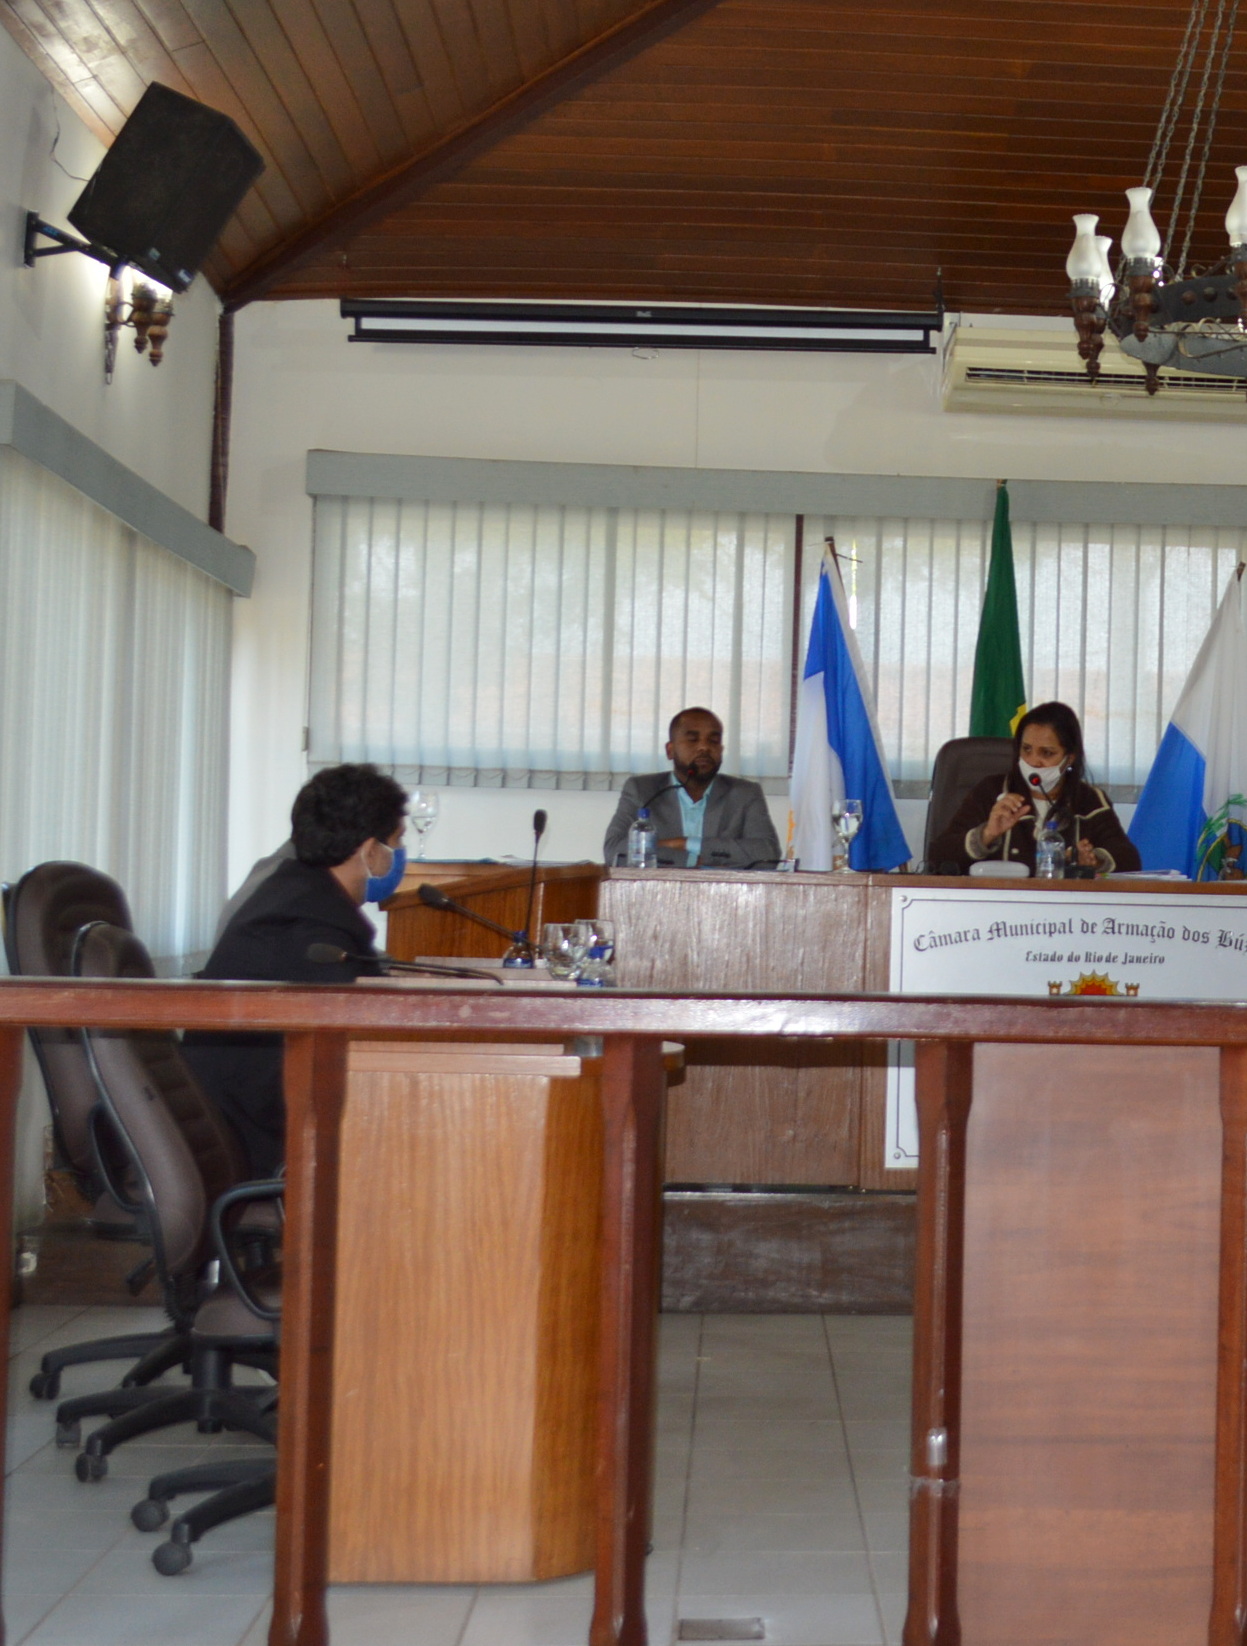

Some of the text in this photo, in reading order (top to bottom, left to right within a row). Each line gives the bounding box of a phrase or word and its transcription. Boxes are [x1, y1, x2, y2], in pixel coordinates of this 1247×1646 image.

[912, 927, 982, 953] Câmara
[986, 917, 1075, 941] Municipal
[1080, 918, 1098, 935] de
[1102, 917, 1176, 944] Armação
[1181, 925, 1211, 945] dos
[1025, 951, 1166, 965] Estado do Rio de Janeiro
